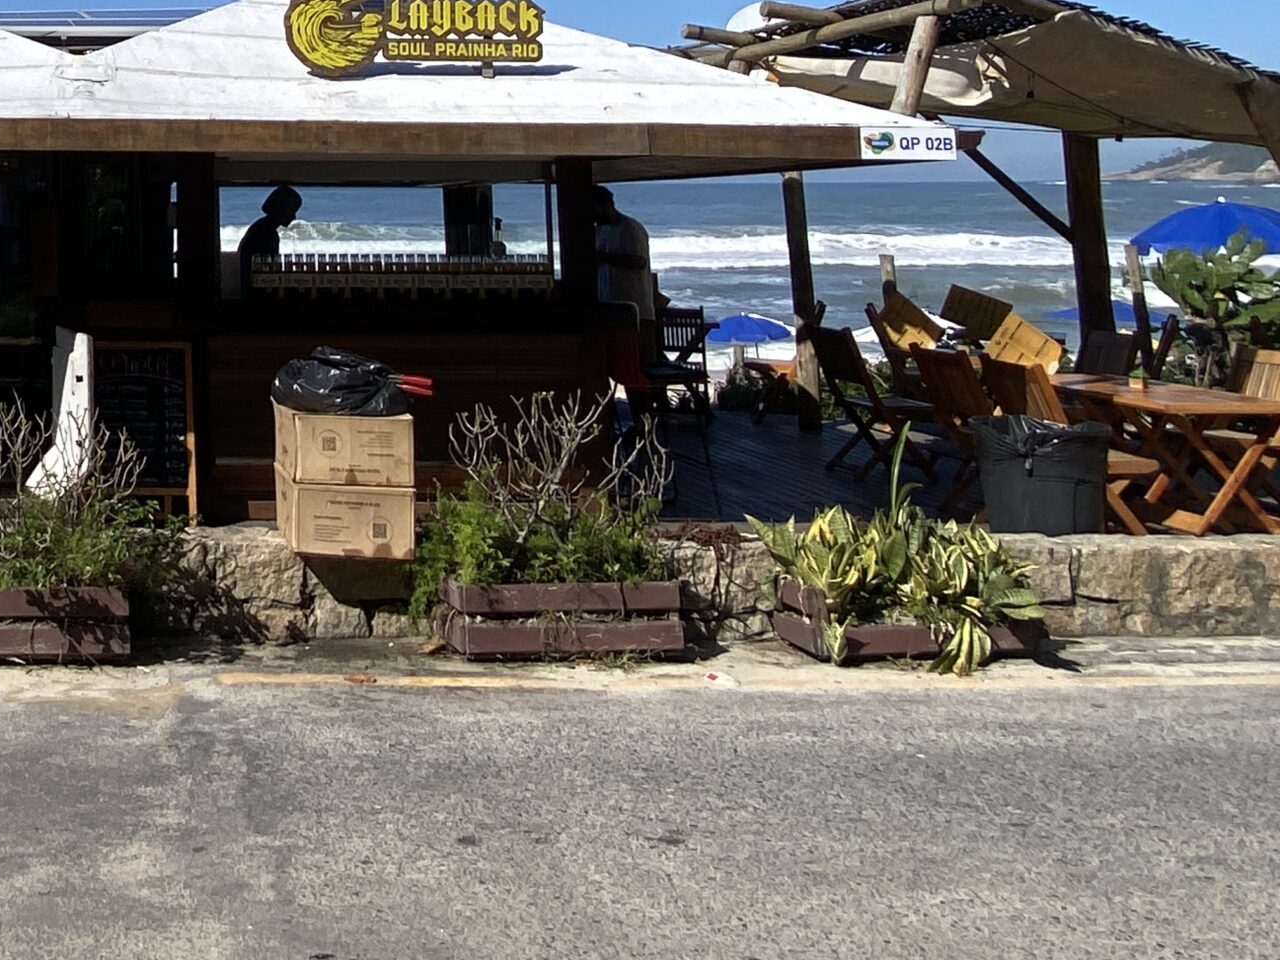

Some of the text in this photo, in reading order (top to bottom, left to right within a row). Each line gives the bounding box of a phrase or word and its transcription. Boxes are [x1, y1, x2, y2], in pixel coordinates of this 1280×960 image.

[388, 42, 539, 58] SOUL PRAINHA RIO
[900, 136, 953, 151] QP 02B
